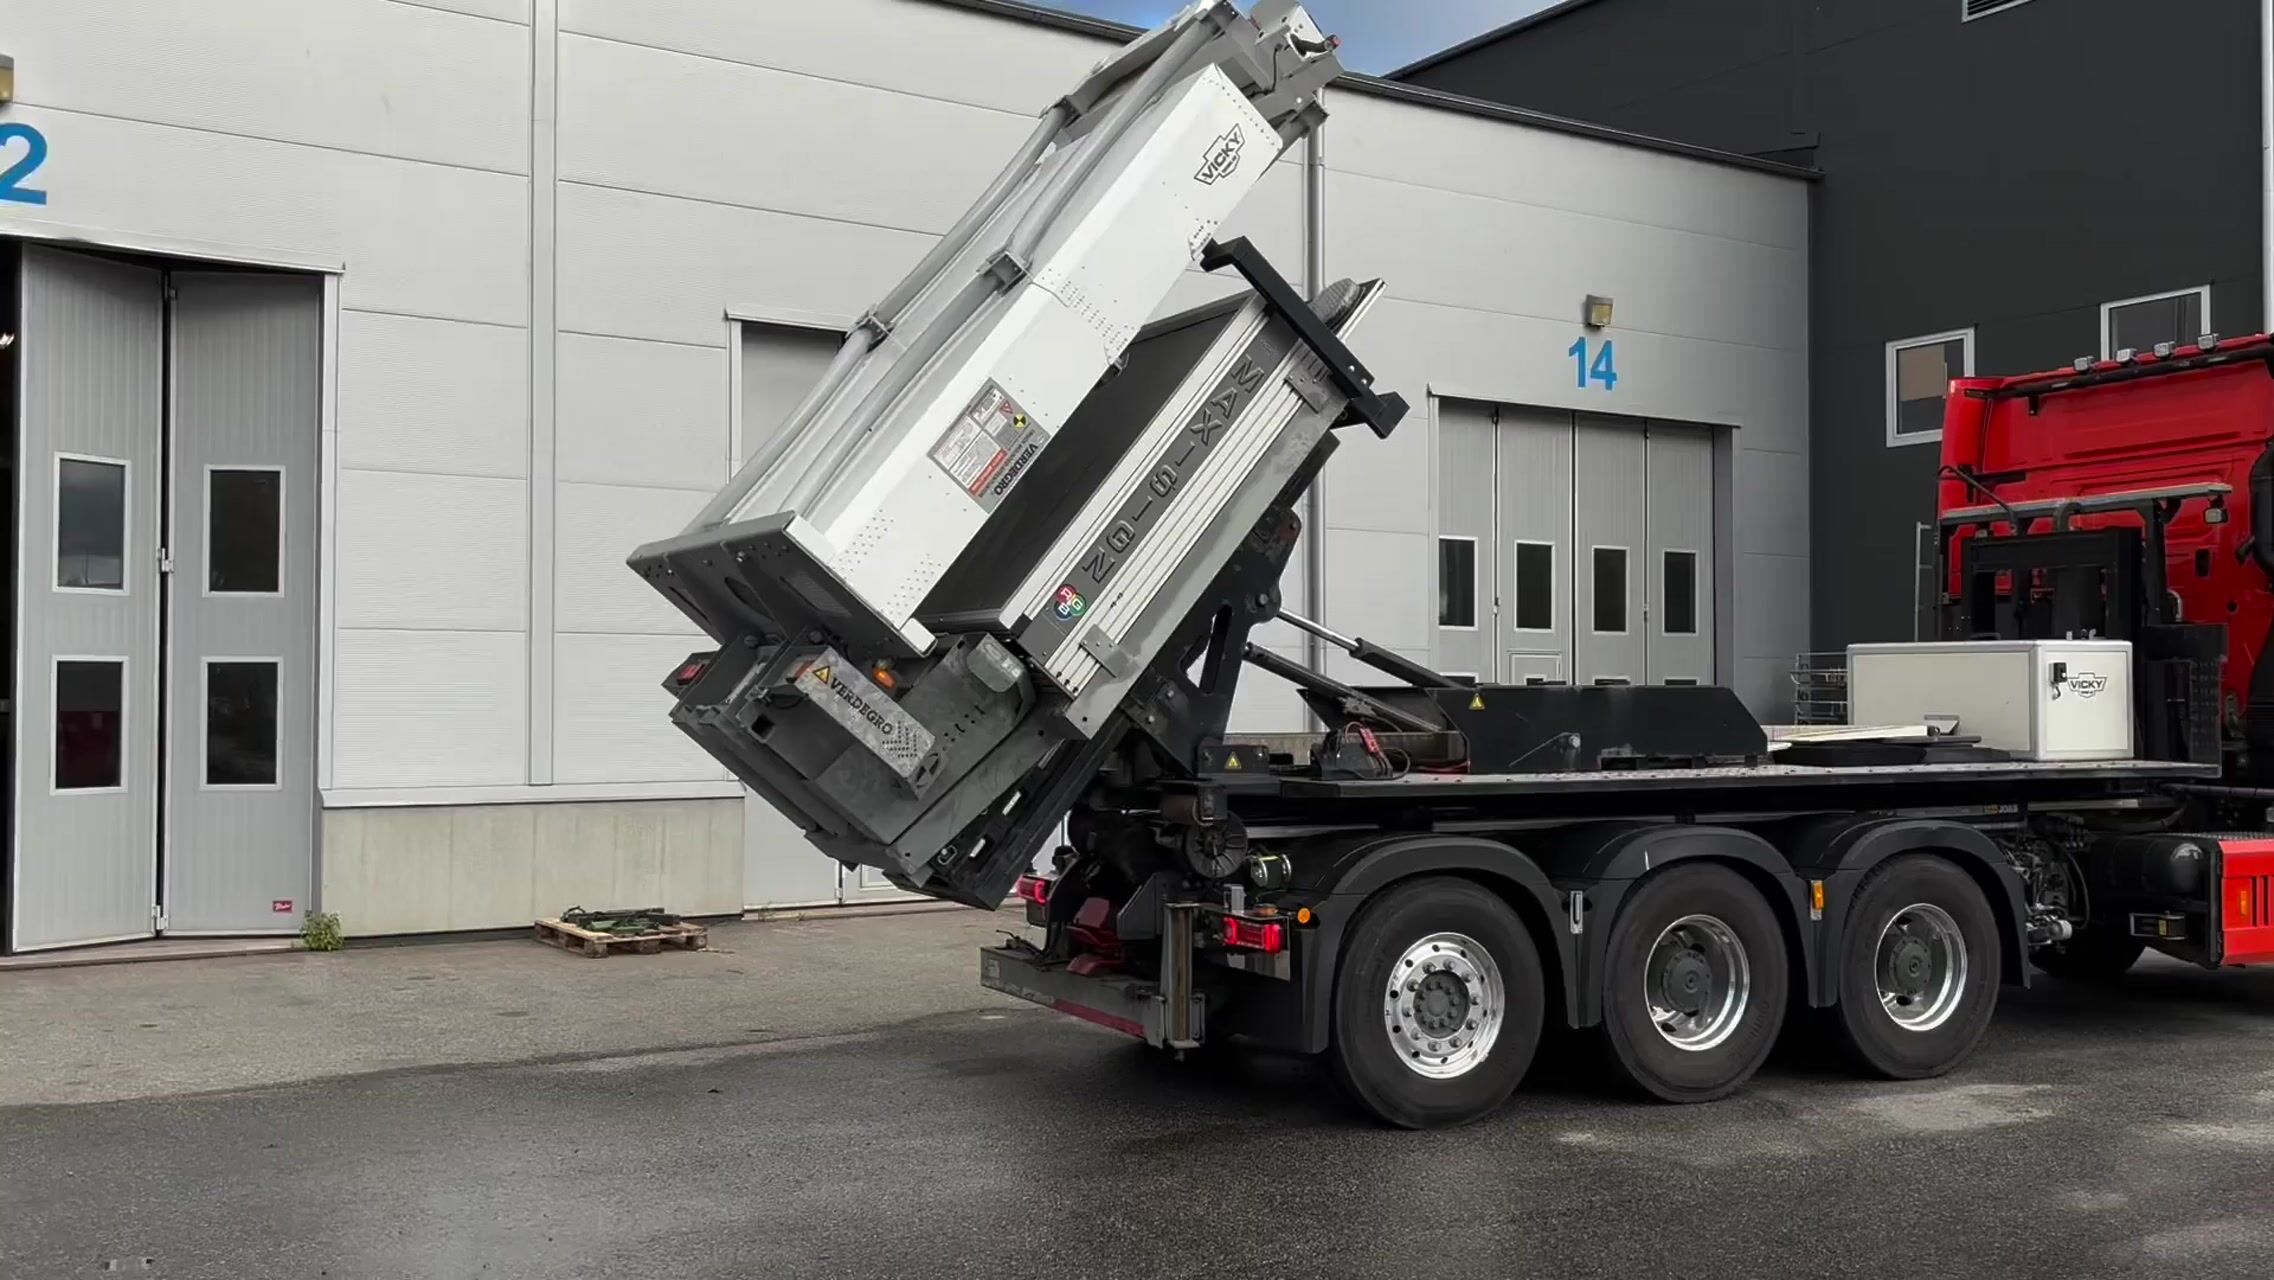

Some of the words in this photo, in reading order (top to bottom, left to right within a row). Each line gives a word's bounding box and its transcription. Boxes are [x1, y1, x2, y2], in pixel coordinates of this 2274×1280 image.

[1202, 132, 1240, 179] VICKY
[1569, 336, 1617, 390] 14
[992, 443, 1037, 496] VERDEGRO
[830, 677, 894, 736] VERDEGRO
[2070, 680, 2103, 689] VICKY
